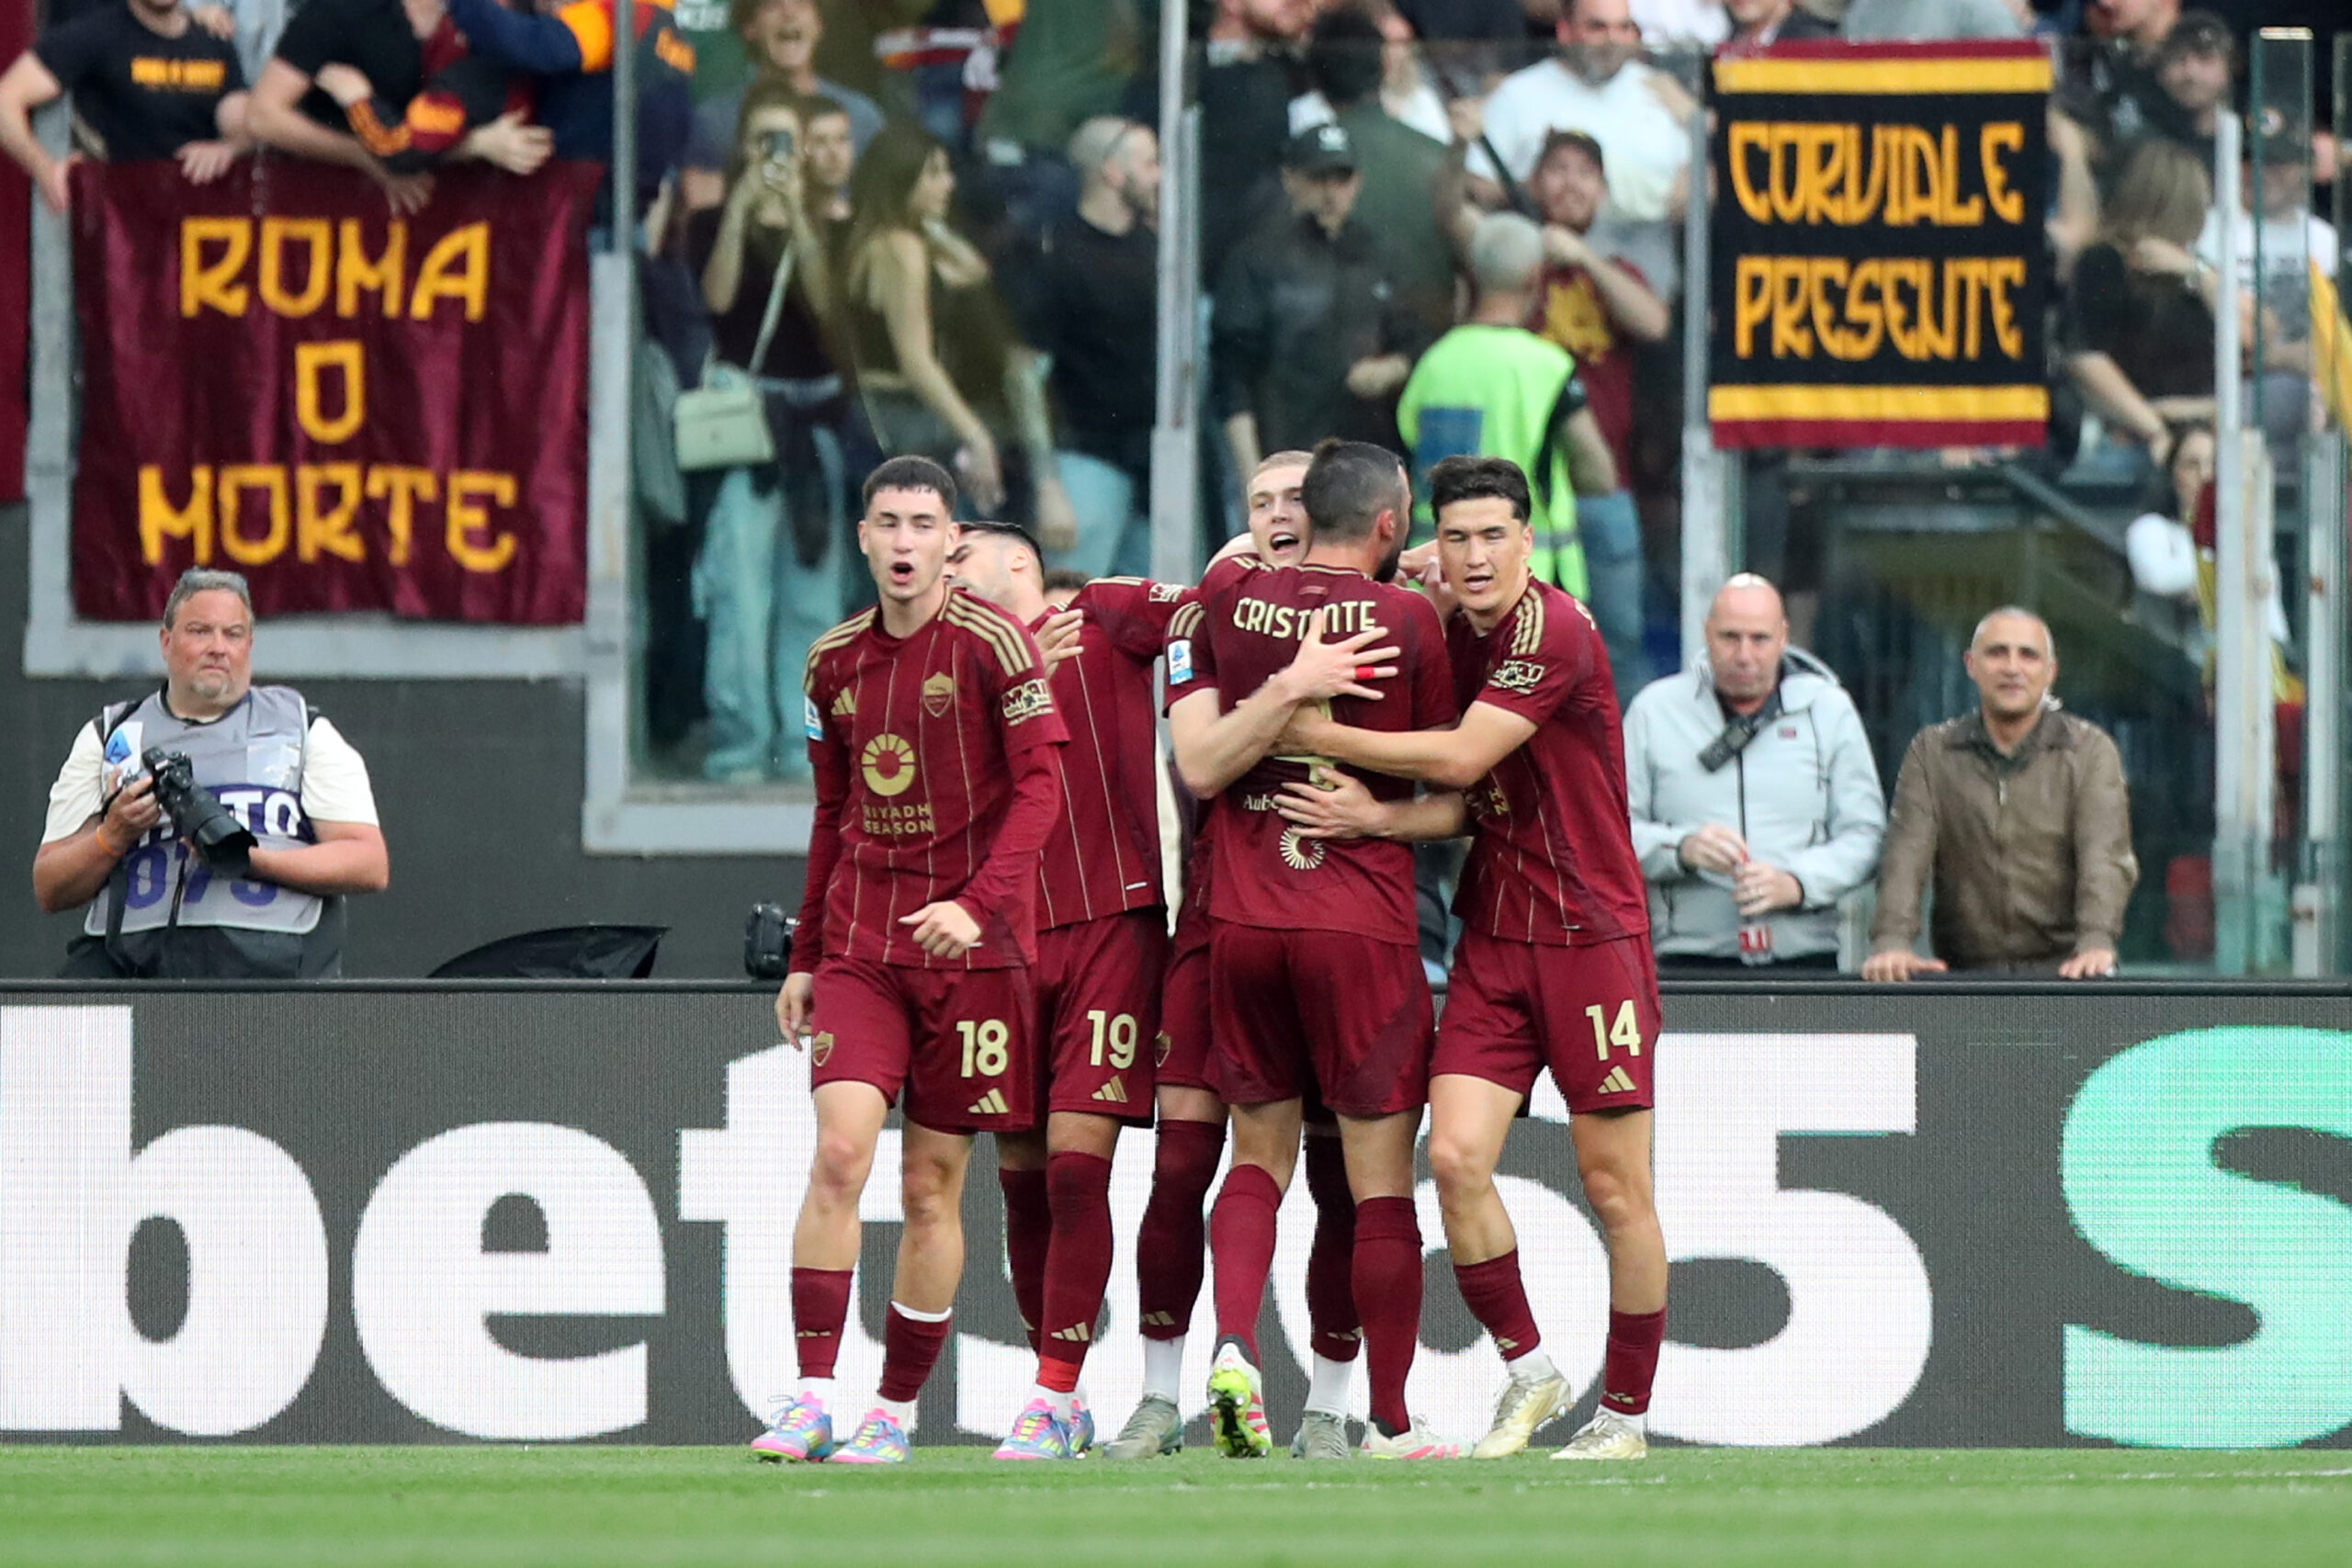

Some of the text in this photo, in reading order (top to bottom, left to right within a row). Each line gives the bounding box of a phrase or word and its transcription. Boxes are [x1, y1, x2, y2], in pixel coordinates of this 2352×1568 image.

[1727, 120, 2024, 226] CORVIALE
[180, 216, 490, 321] ROMA
[1735, 254, 2027, 360] PRESENTE
[294, 340, 365, 445] O
[137, 464, 518, 573] MORTE
[1233, 596, 1376, 641] CRISTNTE
[864, 819, 934, 835] SEASON
[956, 1019, 1009, 1077] 18
[1087, 1010, 1136, 1069] 19
[1585, 998, 1642, 1061] 14
